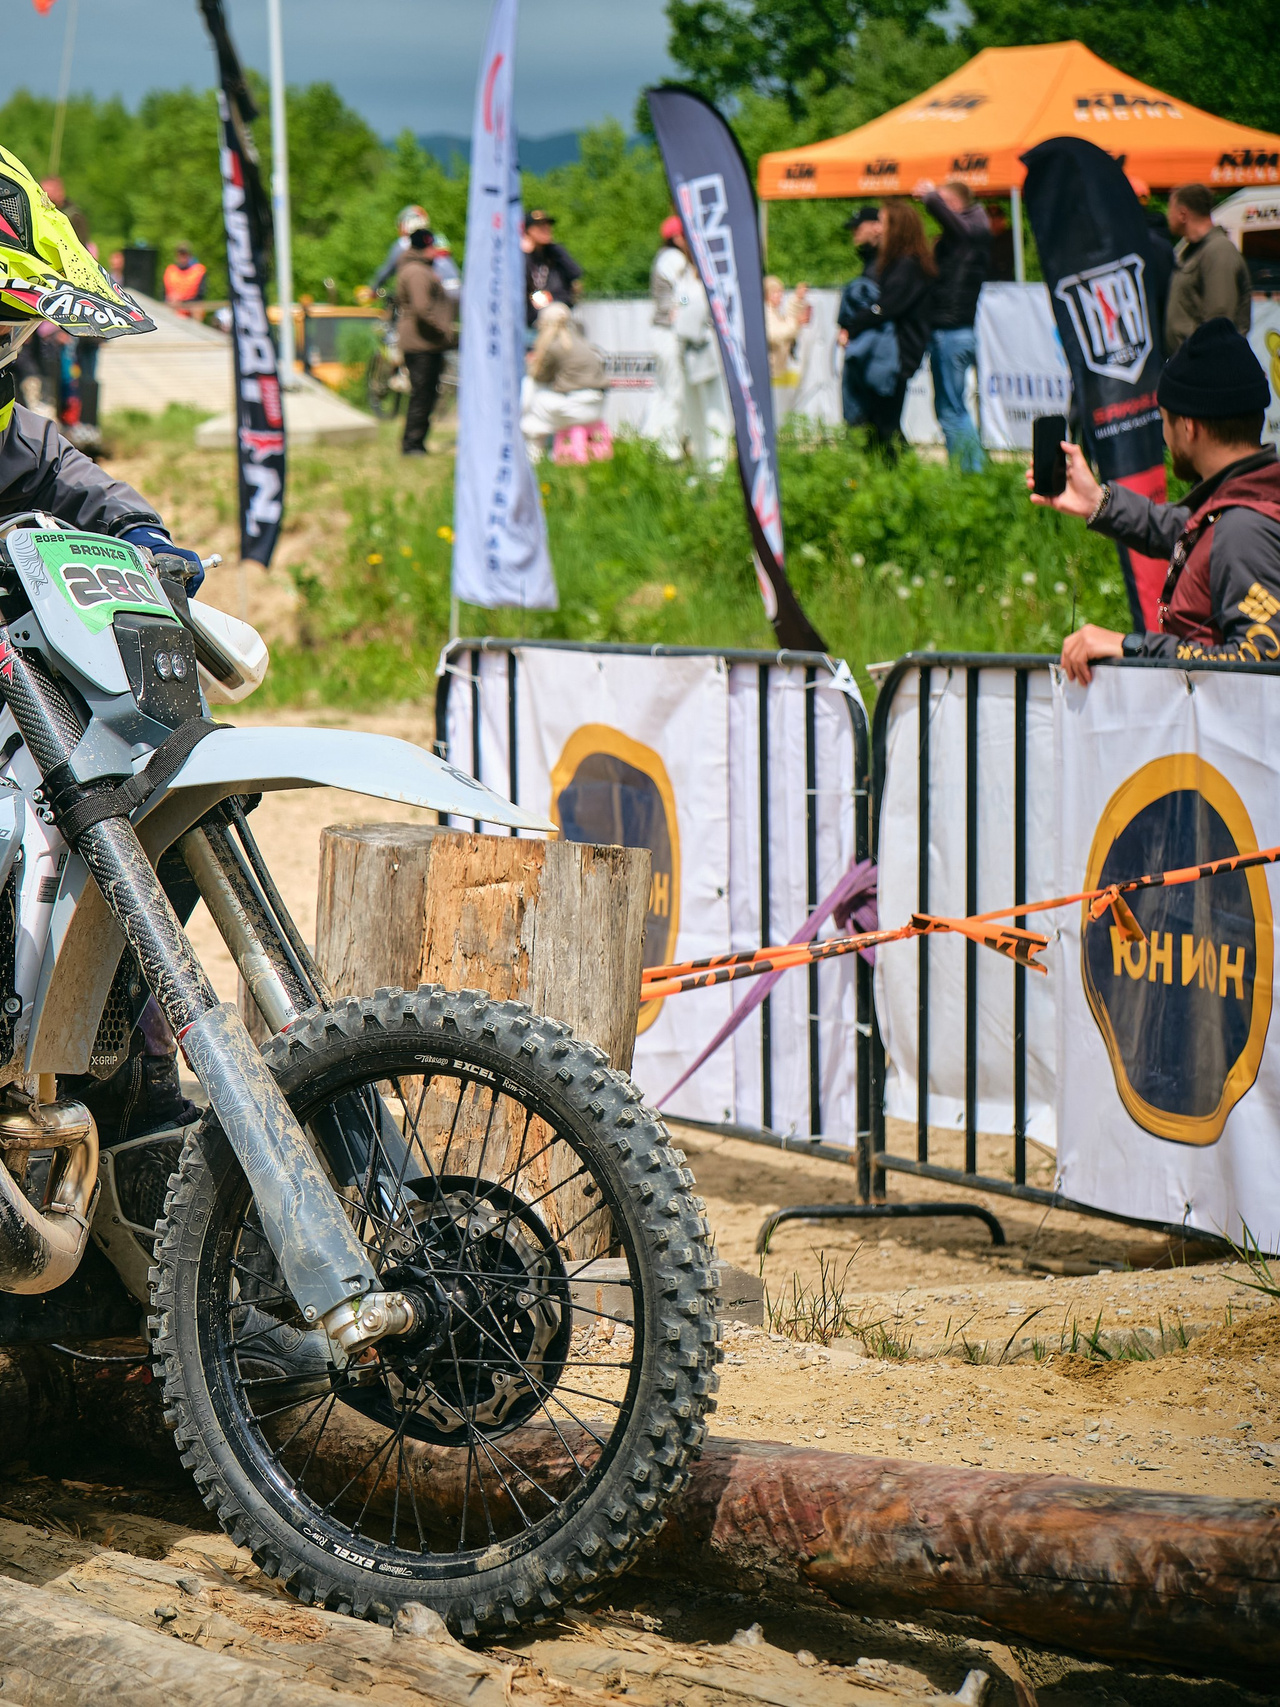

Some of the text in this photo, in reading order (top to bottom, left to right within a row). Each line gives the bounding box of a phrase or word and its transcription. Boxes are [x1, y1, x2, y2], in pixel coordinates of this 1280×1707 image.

[1074, 107, 1184, 123] RACING
[44, 293, 128, 327] Airoh
[59, 562, 164, 611] 280
[452, 1059, 497, 1082] EXCEL
[501, 1078, 528, 1098] Rim
[332, 1543, 377, 1570] EXCEL
